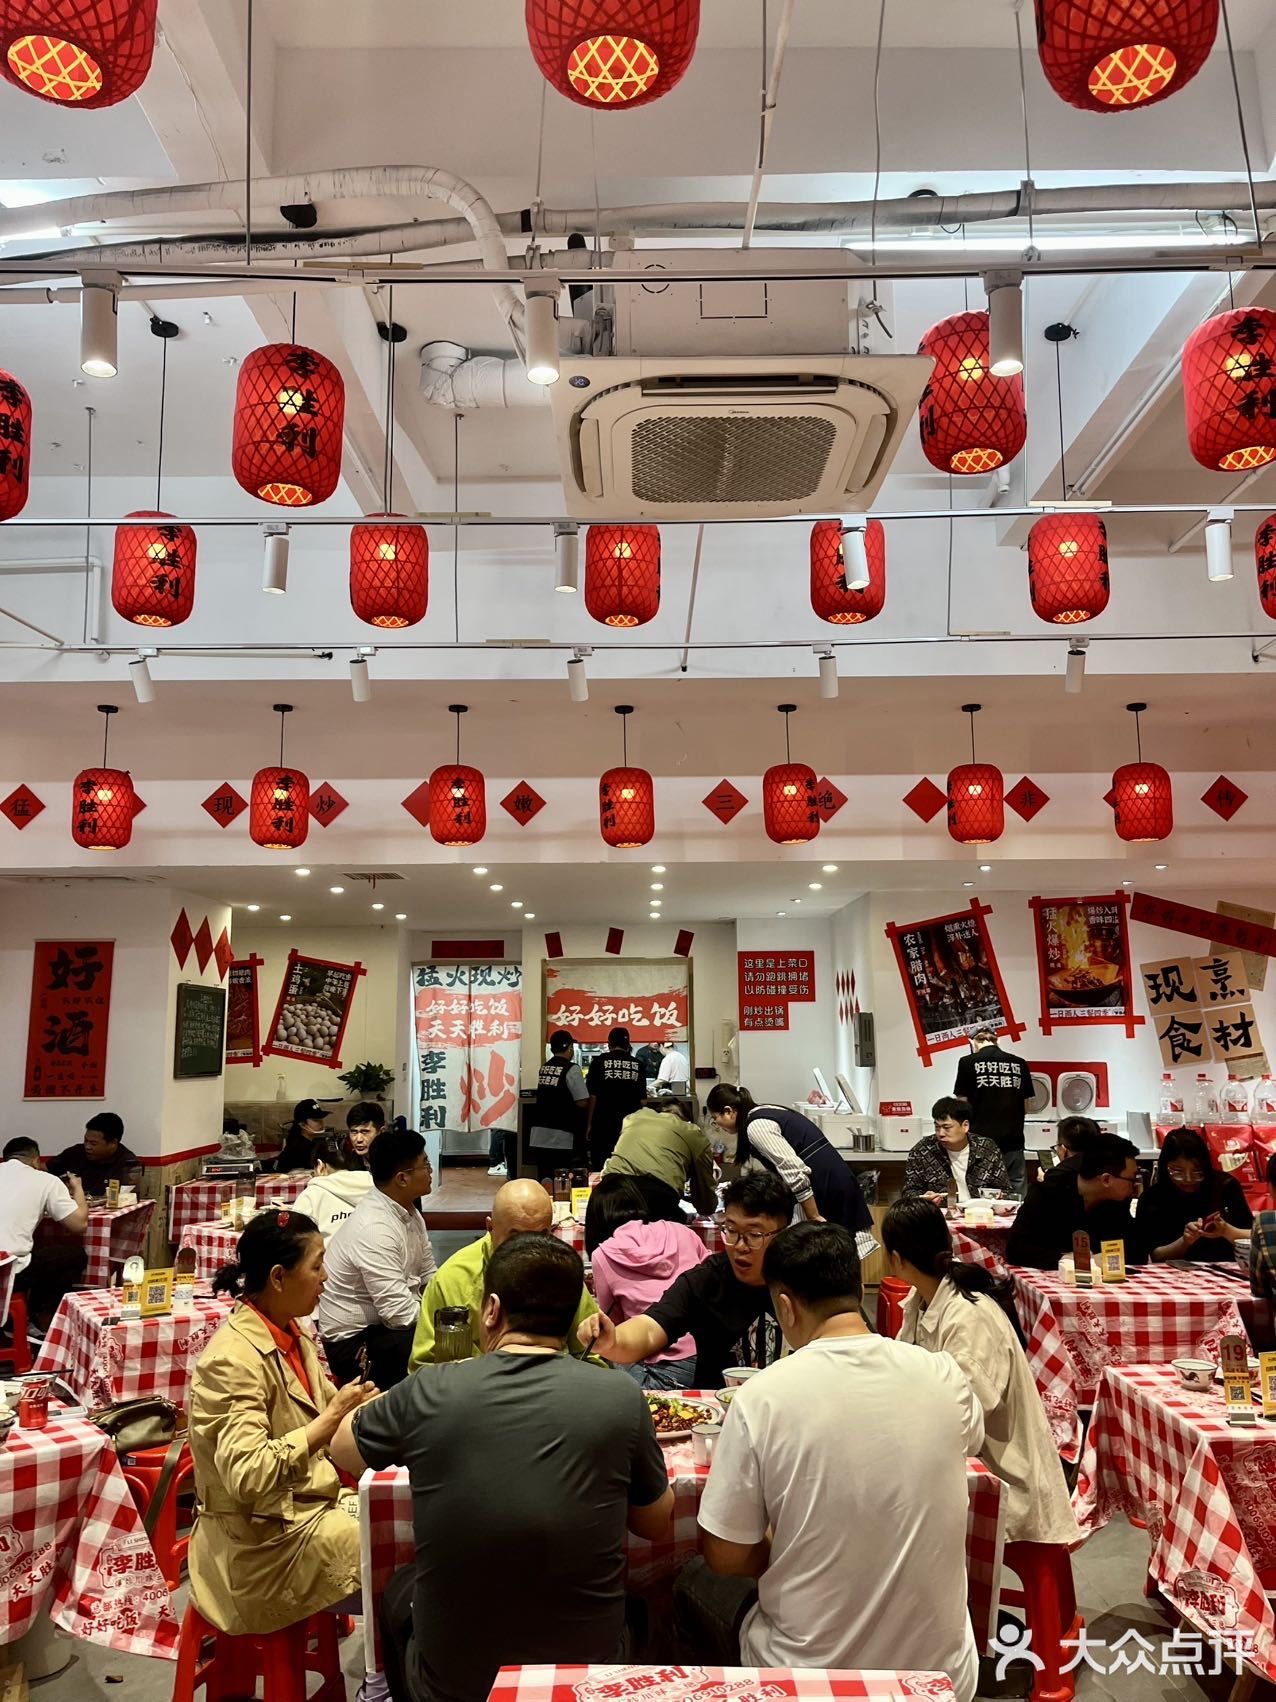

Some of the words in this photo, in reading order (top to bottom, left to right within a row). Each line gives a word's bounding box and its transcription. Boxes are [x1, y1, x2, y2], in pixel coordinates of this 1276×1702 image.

[12, 796, 31, 817] 猛
[80, 780, 98, 834] 李胜利
[214, 796, 235, 816] 现
[271, 775, 295, 833] 李胜利
[316, 794, 336, 815] 炒
[451, 777, 472, 825] 李胜利
[514, 794, 533, 813] 嫩
[716, 794, 735, 811] 三
[819, 791, 836, 810] 绝
[1022, 789, 1037, 809] 非
[744, 958, 808, 969] 这里是上菜口
[903, 933, 927, 986] 农家腊肉
[287, 963, 303, 995] 土鸡蛋
[416, 964, 522, 988] 猛火现炒
[744, 971, 809, 982] 请勿跑跳拥堵
[744, 984, 809, 995] 以防碰撞受伤
[426, 999, 510, 1016] 好好吃饭
[550, 1002, 683, 1027] 好好吃饭
[743, 1005, 784, 1016] 刚炒出锅
[427, 1019, 510, 1039] 天天胜利
[743, 1017, 785, 1027] 有点烫嘴
[604, 1059, 639, 1070] 好好吃饭
[974, 1061, 1021, 1074] 好好吃饭
[604, 1070, 639, 1081] 天天胜利
[976, 1074, 1022, 1089] 天天胜利
[420, 1050, 447, 1129] 李胜利
[460, 1049, 517, 1128] 炒
[1222, 1343, 1245, 1362] 19
[81, 1611, 140, 1636] 好好吃饭
[597, 1666, 690, 1700] 李胜利
